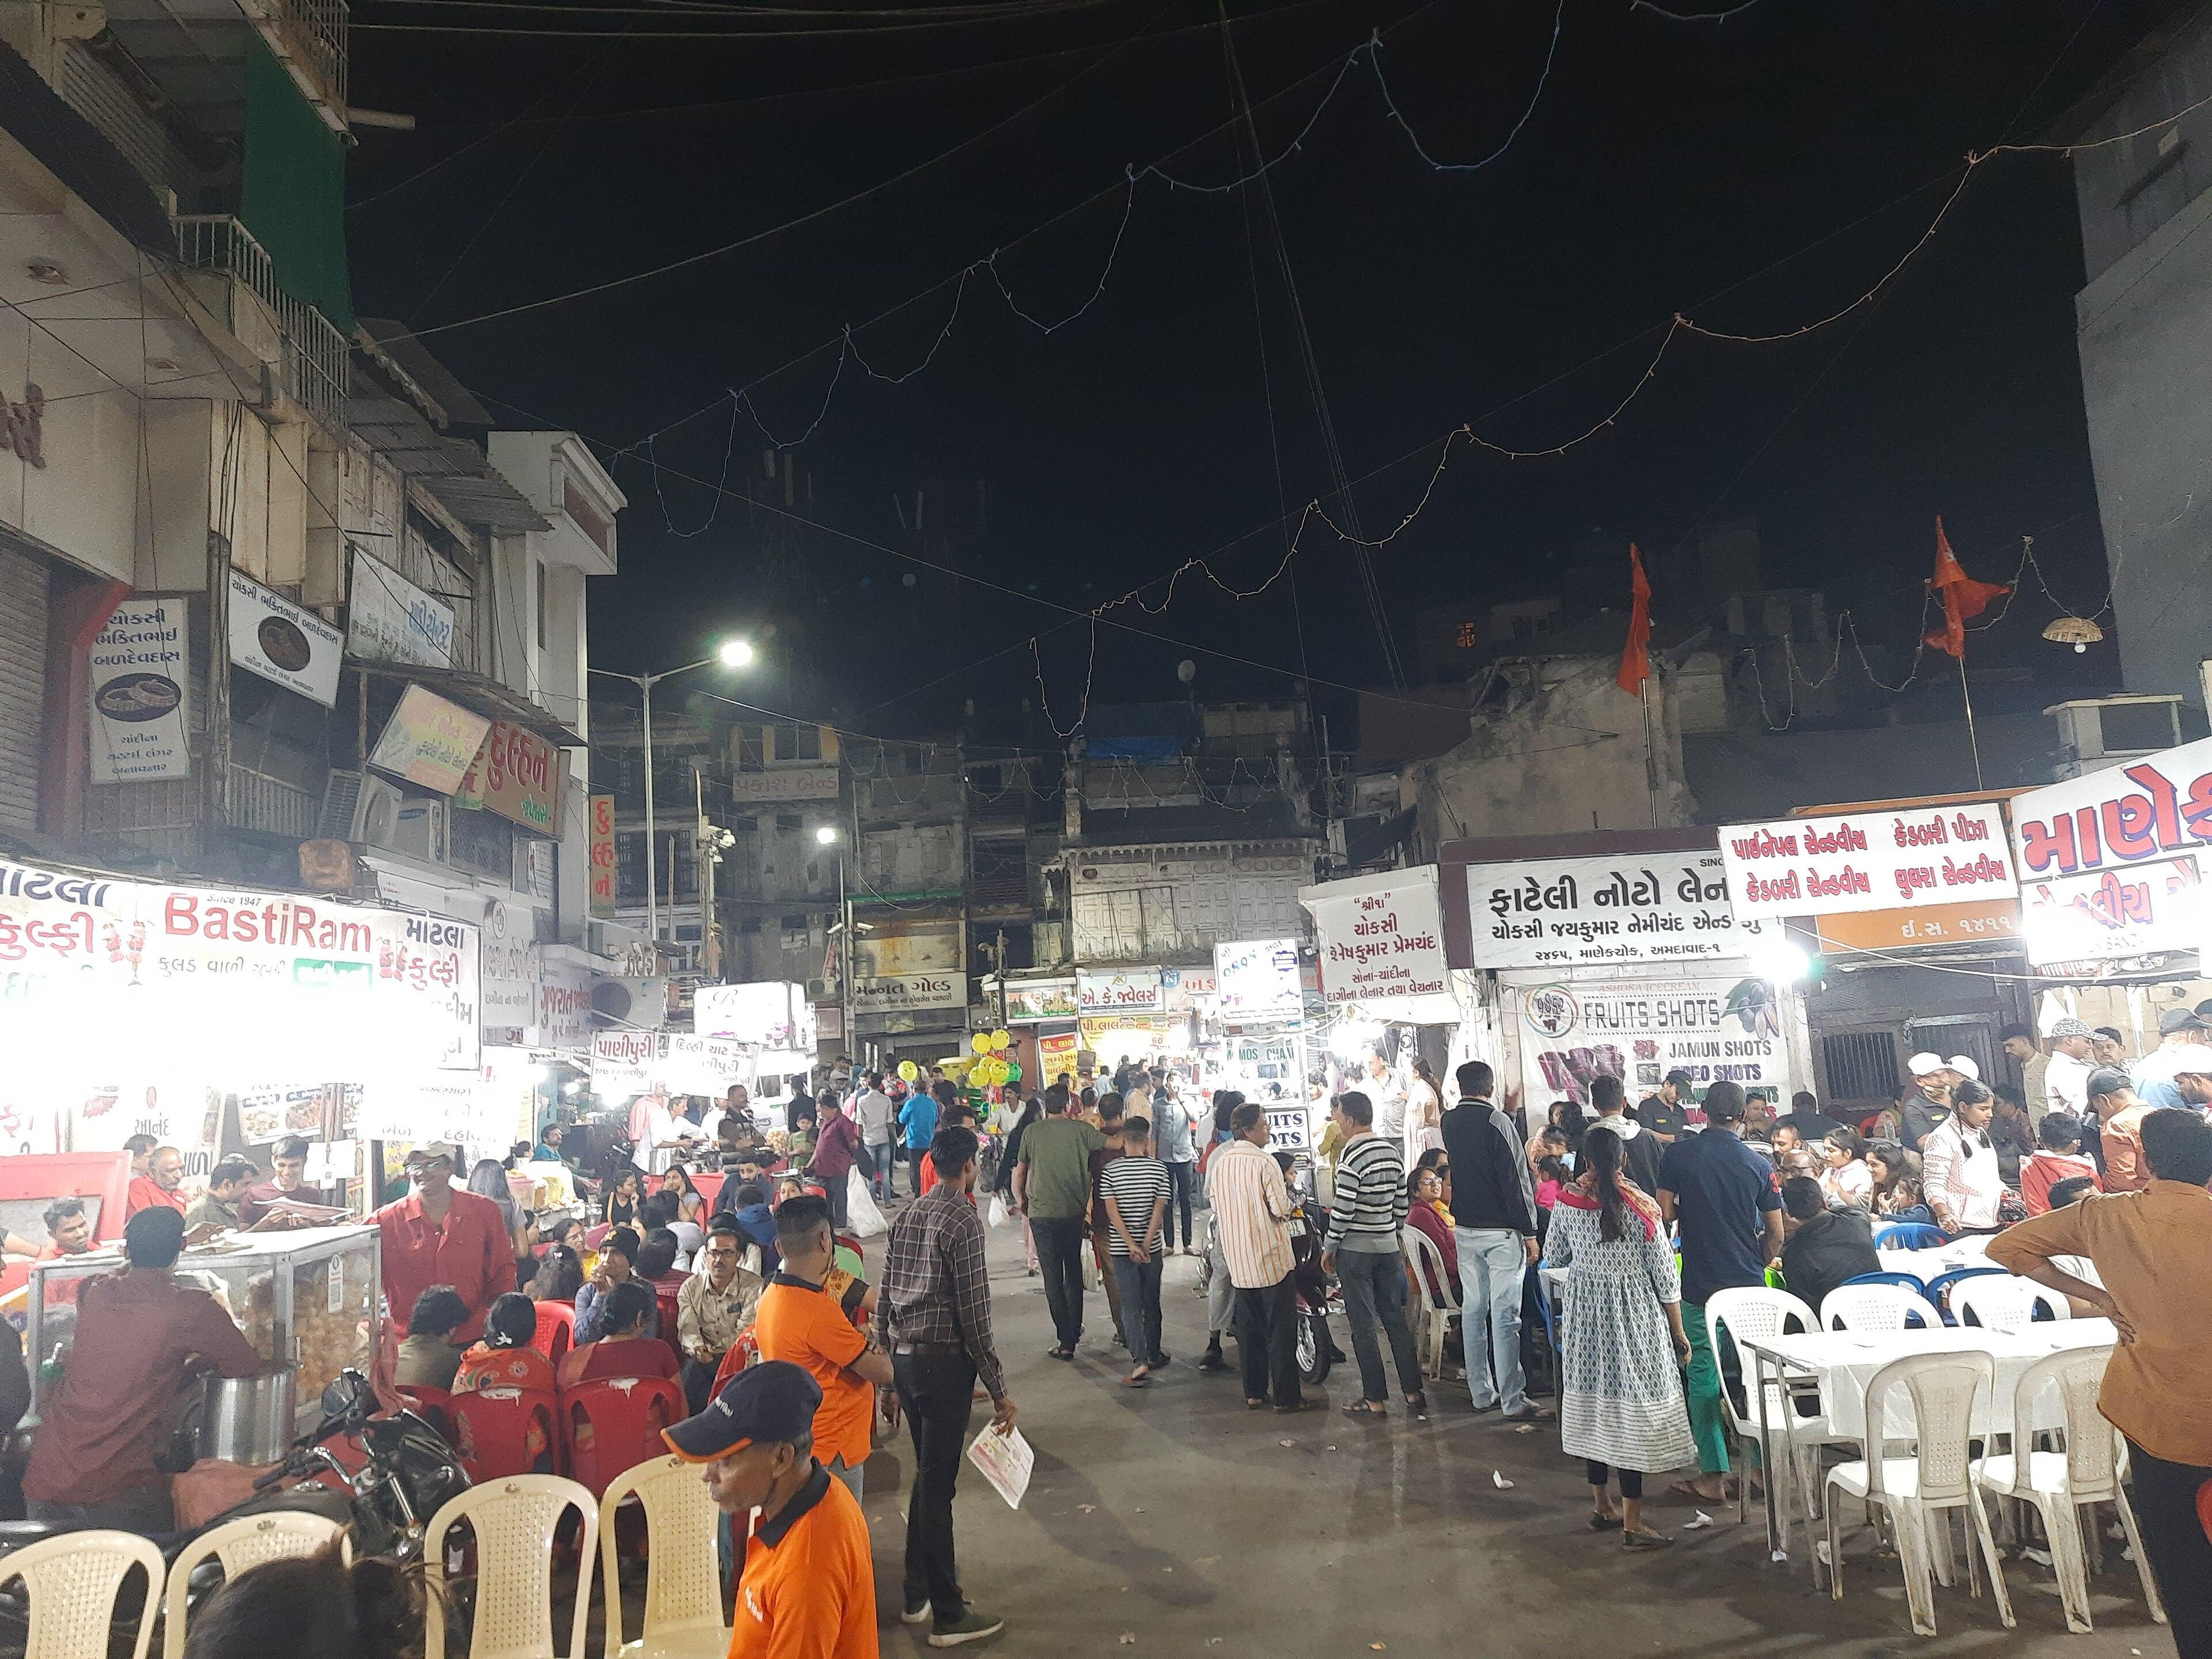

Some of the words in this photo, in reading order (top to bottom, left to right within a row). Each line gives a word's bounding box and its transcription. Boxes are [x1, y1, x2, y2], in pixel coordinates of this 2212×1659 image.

[108, 608, 166, 624] ચોકસી
[1804, 822, 1868, 855] સેન્ડવીચ
[1893, 814, 1949, 848] કેડબરી
[1951, 812, 1990, 842] પીઝા
[1699, 858, 1724, 868] SINC
[1894, 866, 1937, 899] ઘુઘરા
[1942, 853, 2007, 886] સેન્ડવીચ
[0, 868, 111, 907] ાટલા
[1488, 874, 1578, 918] ફાટેલી
[1593, 870, 1661, 907] નોટો
[1746, 869, 1801, 903] કેડબરી
[1806, 865, 1872, 897] સેન્ડવીચ
[239, 896, 262, 907] 1947
[165, 893, 372, 953] BastiRam
[407, 918, 465, 949] માટલા
[1354, 912, 1399, 936] ચોકસી
[1491, 918, 1544, 940] ચોકસી
[1550, 920, 1620, 943] જયકુમાર
[1627, 911, 1685, 933] નેમીચંદ
[1692, 909, 1732, 930] એન્ડ
[1393, 931, 1437, 953] પ્રેમચંદ
[1580, 944, 1643, 958] માણેકચોક,
[1650, 943, 1721, 955] અમદાવાદ-૧
[408, 952, 459, 991] કુલ્ફી
[911, 977, 951, 993] ગોલ્ડ
[1352, 965, 1411, 984] સોના-ચાંદીના
[1327, 987, 1357, 1002] દાગીના
[1359, 985, 1385, 999] લેનાર
[1387, 984, 1406, 997] તથા
[1409, 979, 1444, 994] વેચનાર
[1599, 983, 1643, 992] ASHOKA
[1645, 981, 1702, 992] ICECREAM
[1584, 999, 1649, 1029] FRUITS
[1657, 999, 1720, 1028] SHOTS
[599, 1035, 652, 1065] પાણીપુરી
[1669, 1042, 1722, 1059] JAMUN
[1724, 1039, 1772, 1057] SHOTS
[1713, 1063, 1762, 1082] SHOTS
